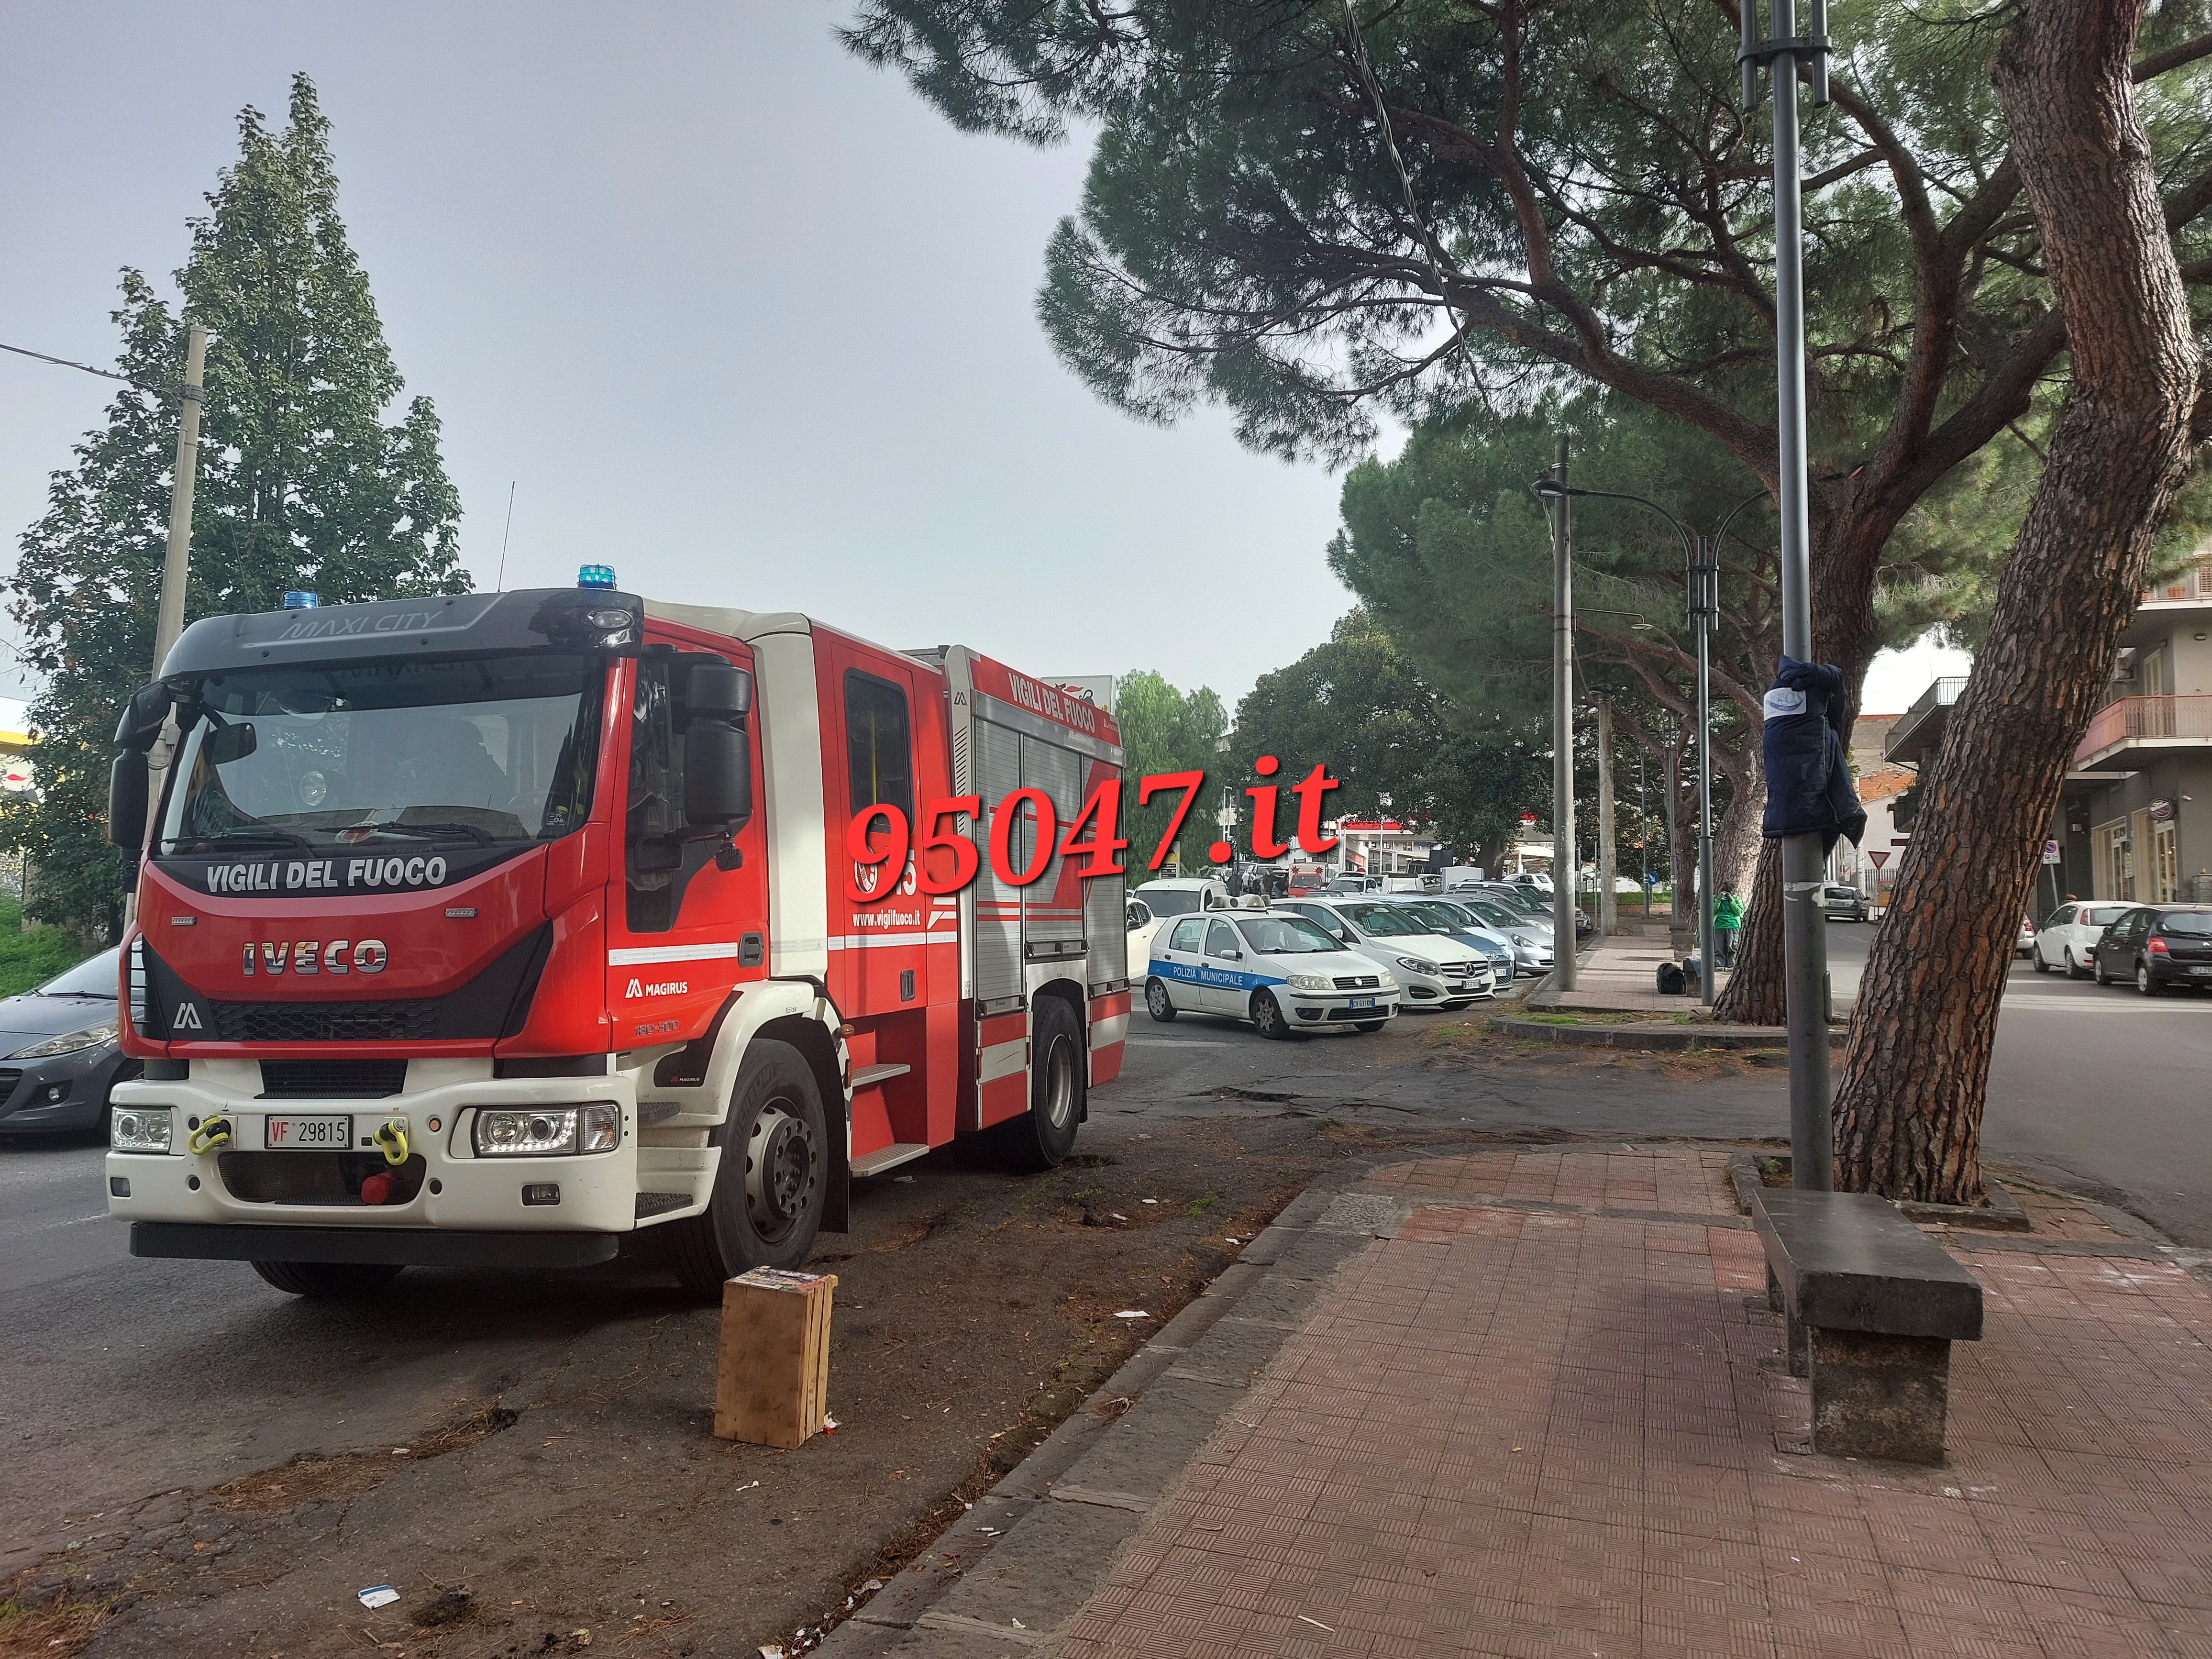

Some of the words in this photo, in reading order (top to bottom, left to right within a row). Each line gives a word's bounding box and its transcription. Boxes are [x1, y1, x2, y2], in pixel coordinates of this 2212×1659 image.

[277, 616, 369, 640] MAXI
[375, 611, 443, 631] CITY
[1008, 672, 1042, 712] VIGILI
[1042, 687, 1064, 721] DEL
[1063, 697, 1095, 733] FUOCO
[207, 863, 279, 892] VIGILI
[287, 861, 338, 889] DEL
[348, 856, 447, 886] FUOCO
[852, 908, 920, 929] www.vigilfuoco.it
[243, 939, 388, 976] IVECO
[645, 981, 688, 996] MAGIRUS
[1173, 966, 1196, 979] POLIZIA
[1201, 970, 1243, 986] MUNICIPALE
[272, 1121, 289, 1142] VF
[298, 1121, 345, 1142] 29815
